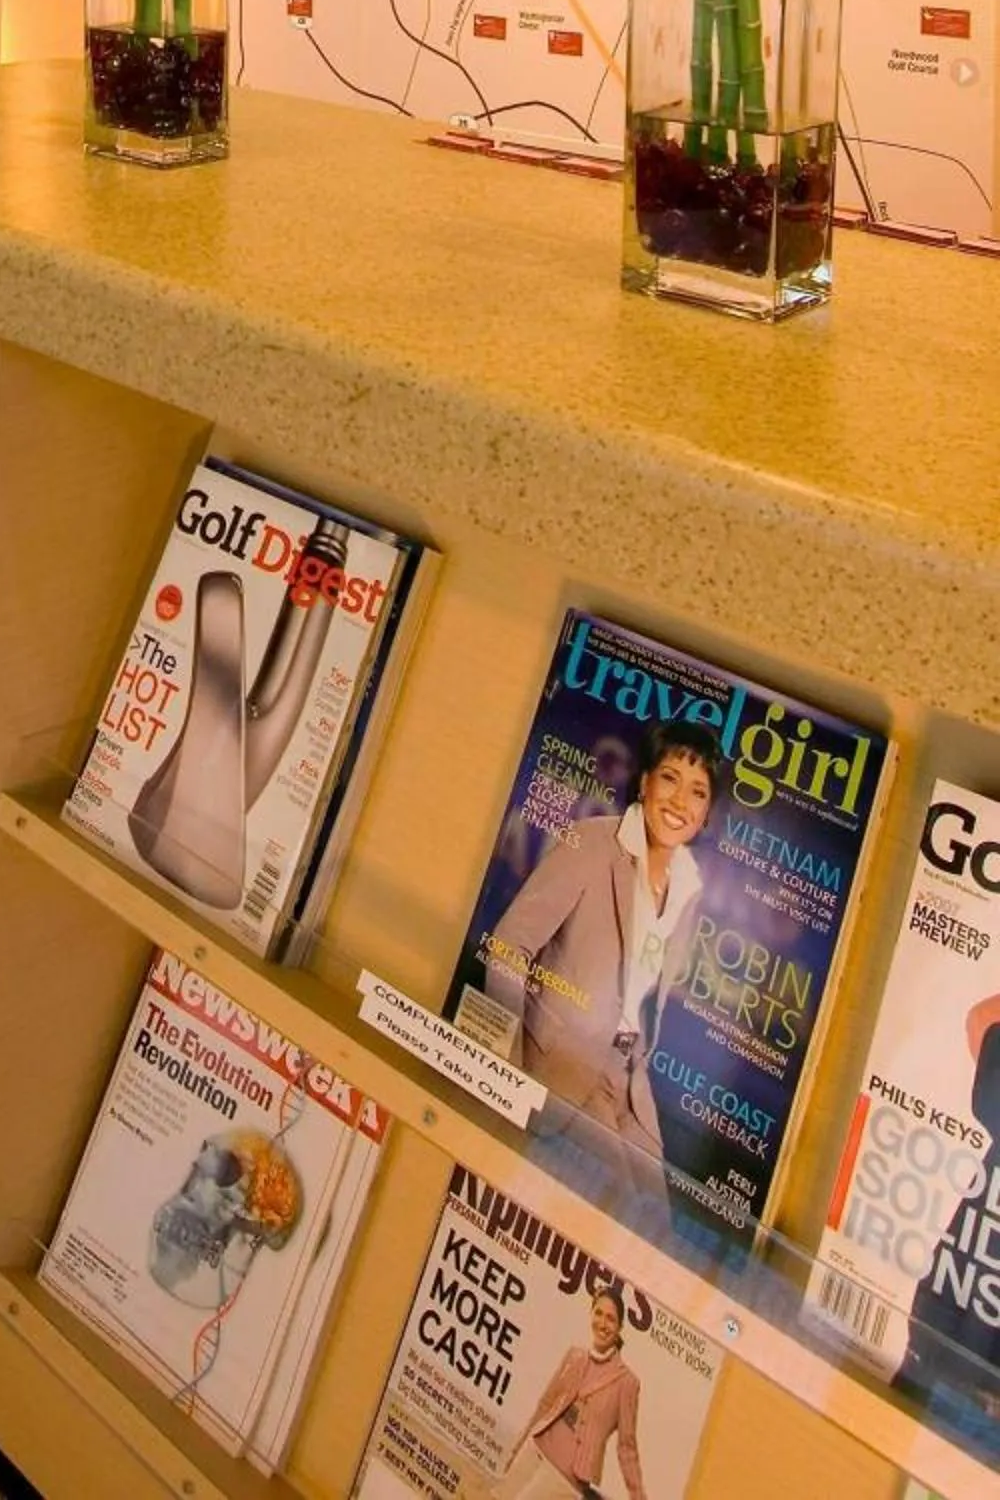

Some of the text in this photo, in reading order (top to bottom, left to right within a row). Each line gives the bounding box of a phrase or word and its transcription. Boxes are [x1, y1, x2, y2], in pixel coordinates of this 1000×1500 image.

[175, 488, 388, 623] Golf Digest
[116, 658, 180, 714] HOT
[103, 695, 167, 753] LIST
[540, 734, 599, 775] SPRING
[521, 795, 549, 816] AND
[528, 782, 575, 813] CLOSET
[536, 752, 617, 806] CLEANING
[520, 812, 582, 850] FINANCES
[725, 813, 842, 893] VIETNAM
[718, 840, 838, 907] CULTURE & COUTURE
[909, 917, 984, 962] PREVIEW
[913, 902, 991, 949] MASTERS
[640, 929, 803, 1049] ROBERTS
[693, 914, 812, 1009] ROBIN
[146, 1002, 180, 1045] The
[181, 1025, 273, 1112] Evolution
[373, 984, 526, 1089] COMPLIMENTARY
[376, 1011, 429, 1053] Please
[434, 1049, 473, 1084] Take
[477, 1081, 513, 1111] One
[706, 1030, 727, 1047] AND
[134, 1028, 238, 1120] Revolution
[652, 1050, 776, 1137] GULF COAST
[680, 1093, 769, 1160] COMEBACK
[868, 1075, 984, 1151] PHIL'S KEYS
[706, 1175, 752, 1213] AUSTRIA
[727, 1169, 757, 1198] PERU
[441, 1227, 527, 1306] KEEP
[429, 1266, 521, 1363] MORE
[418, 1309, 512, 1406] CASH!
